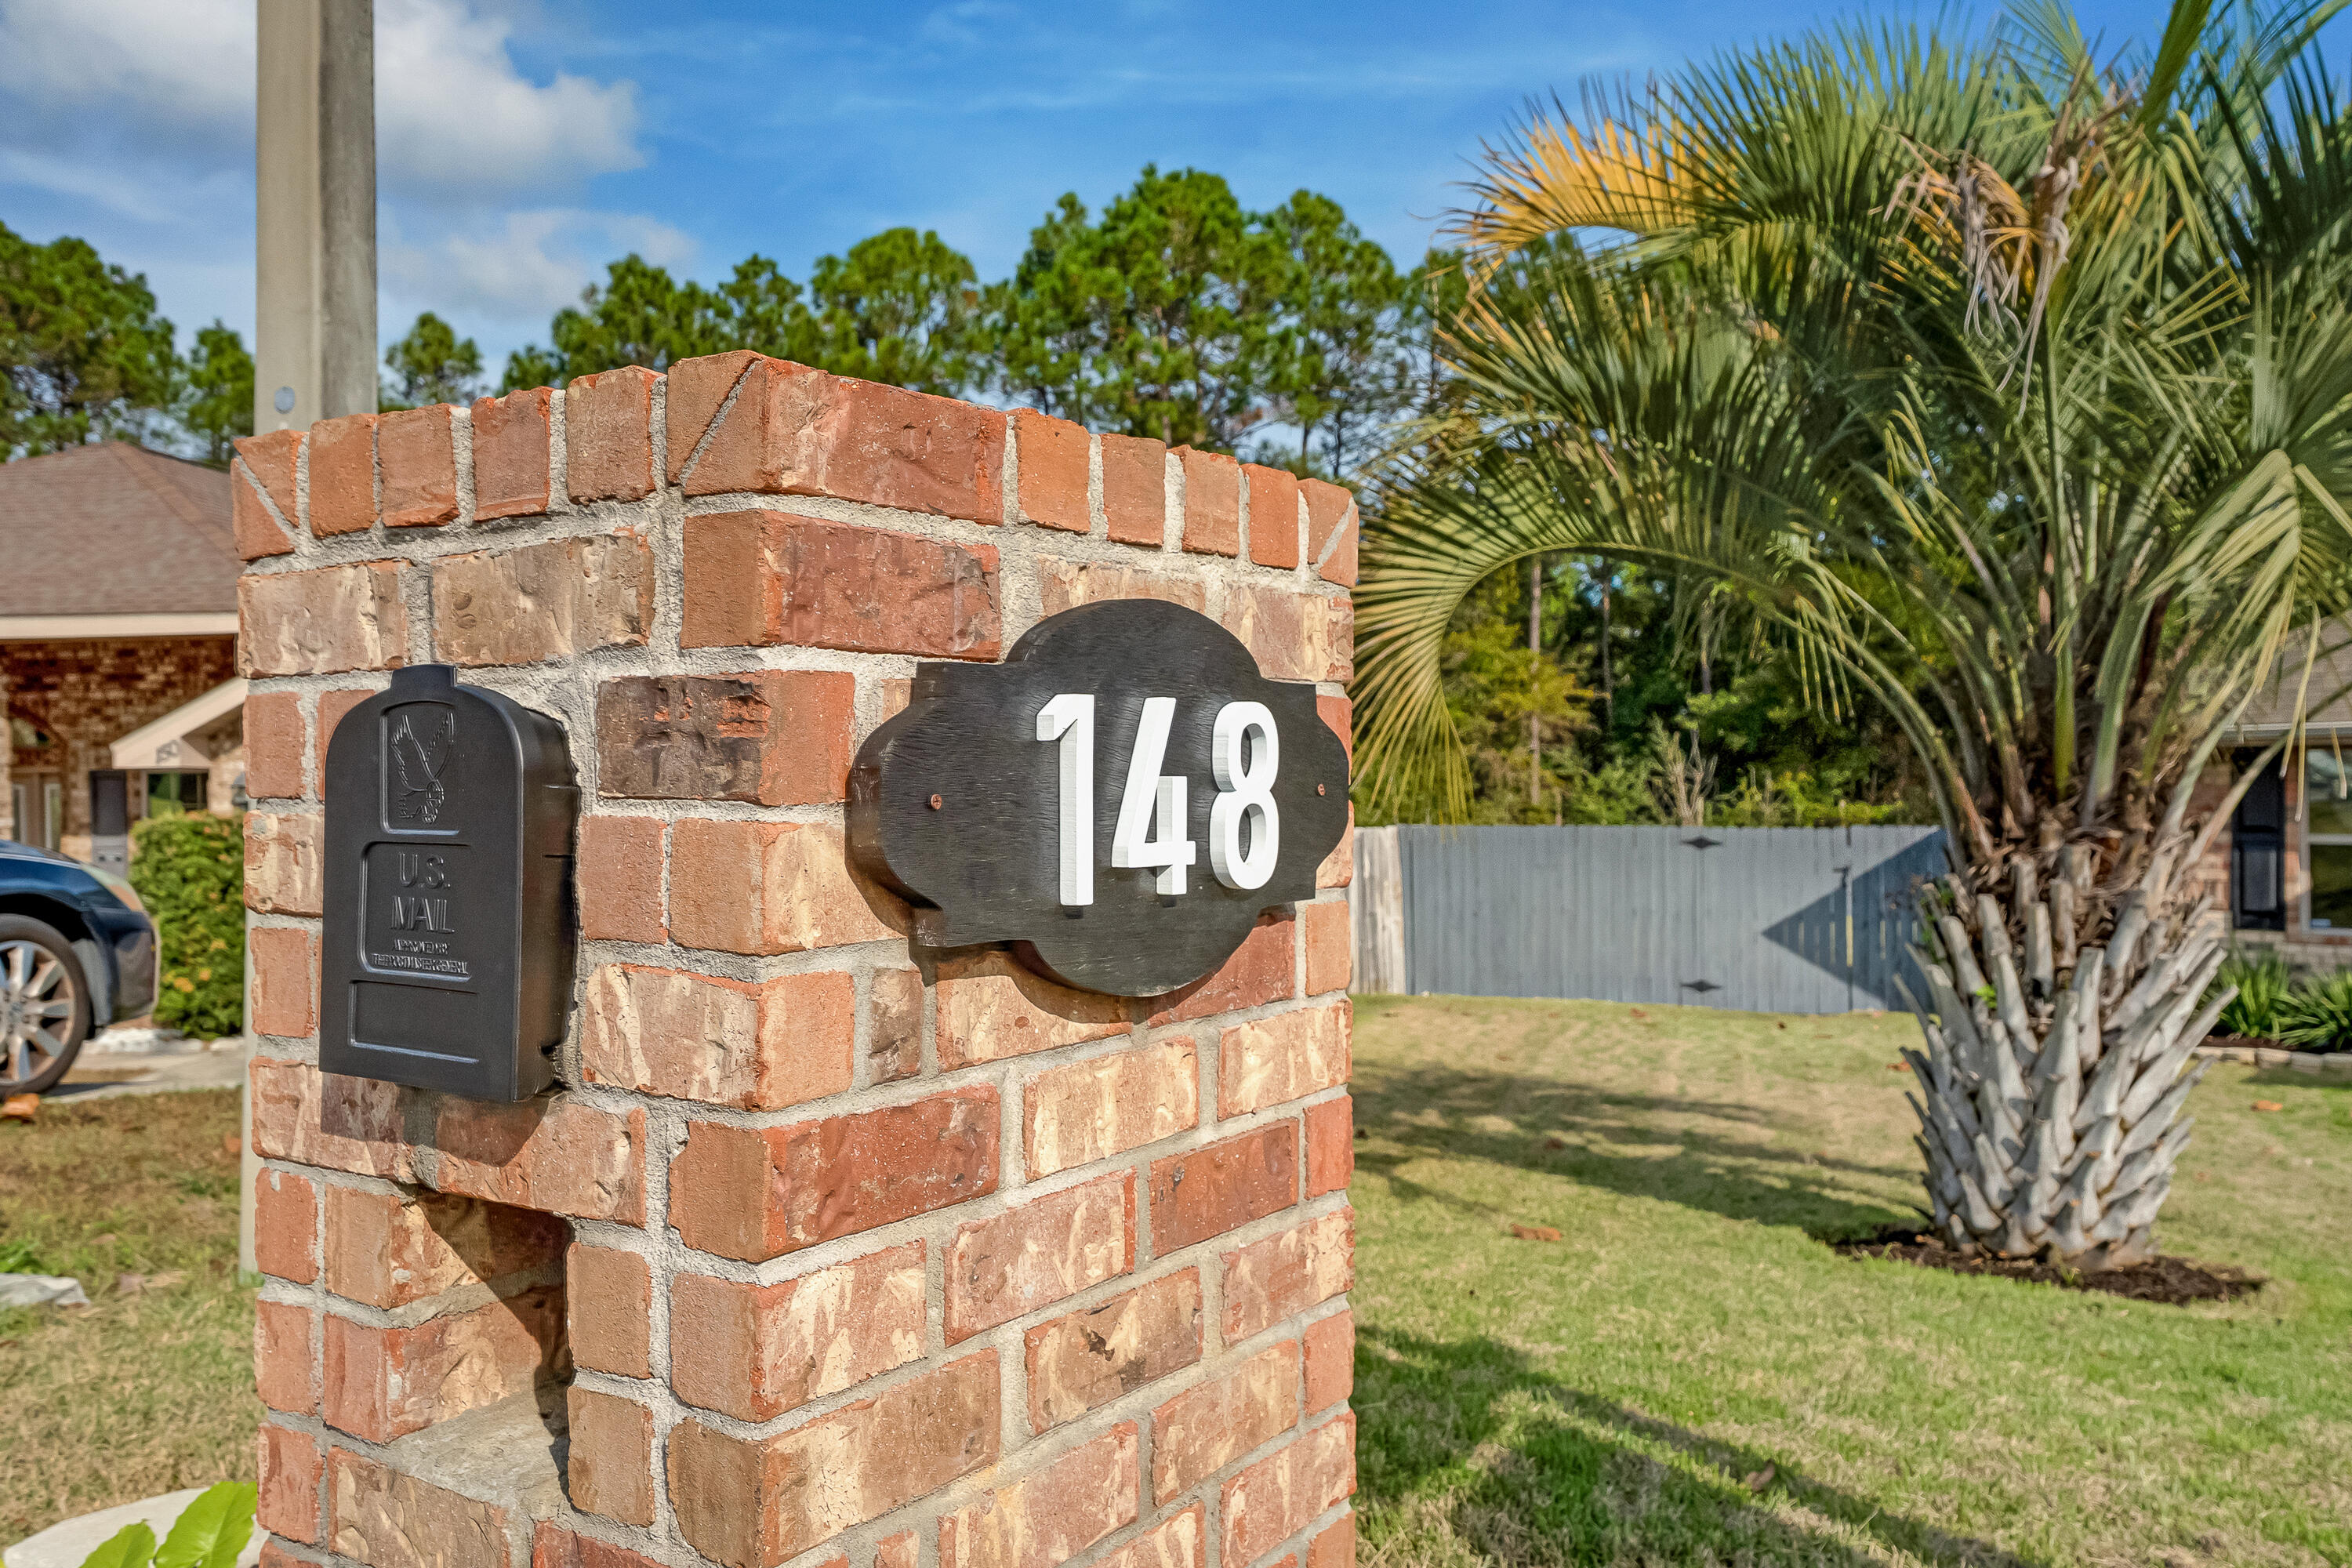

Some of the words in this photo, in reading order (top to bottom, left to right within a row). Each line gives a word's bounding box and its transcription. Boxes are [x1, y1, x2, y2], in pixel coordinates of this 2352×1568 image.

[1036, 693, 1279, 906] 148
[397, 851, 451, 888] U.S.
[392, 896, 455, 933] MAIL
